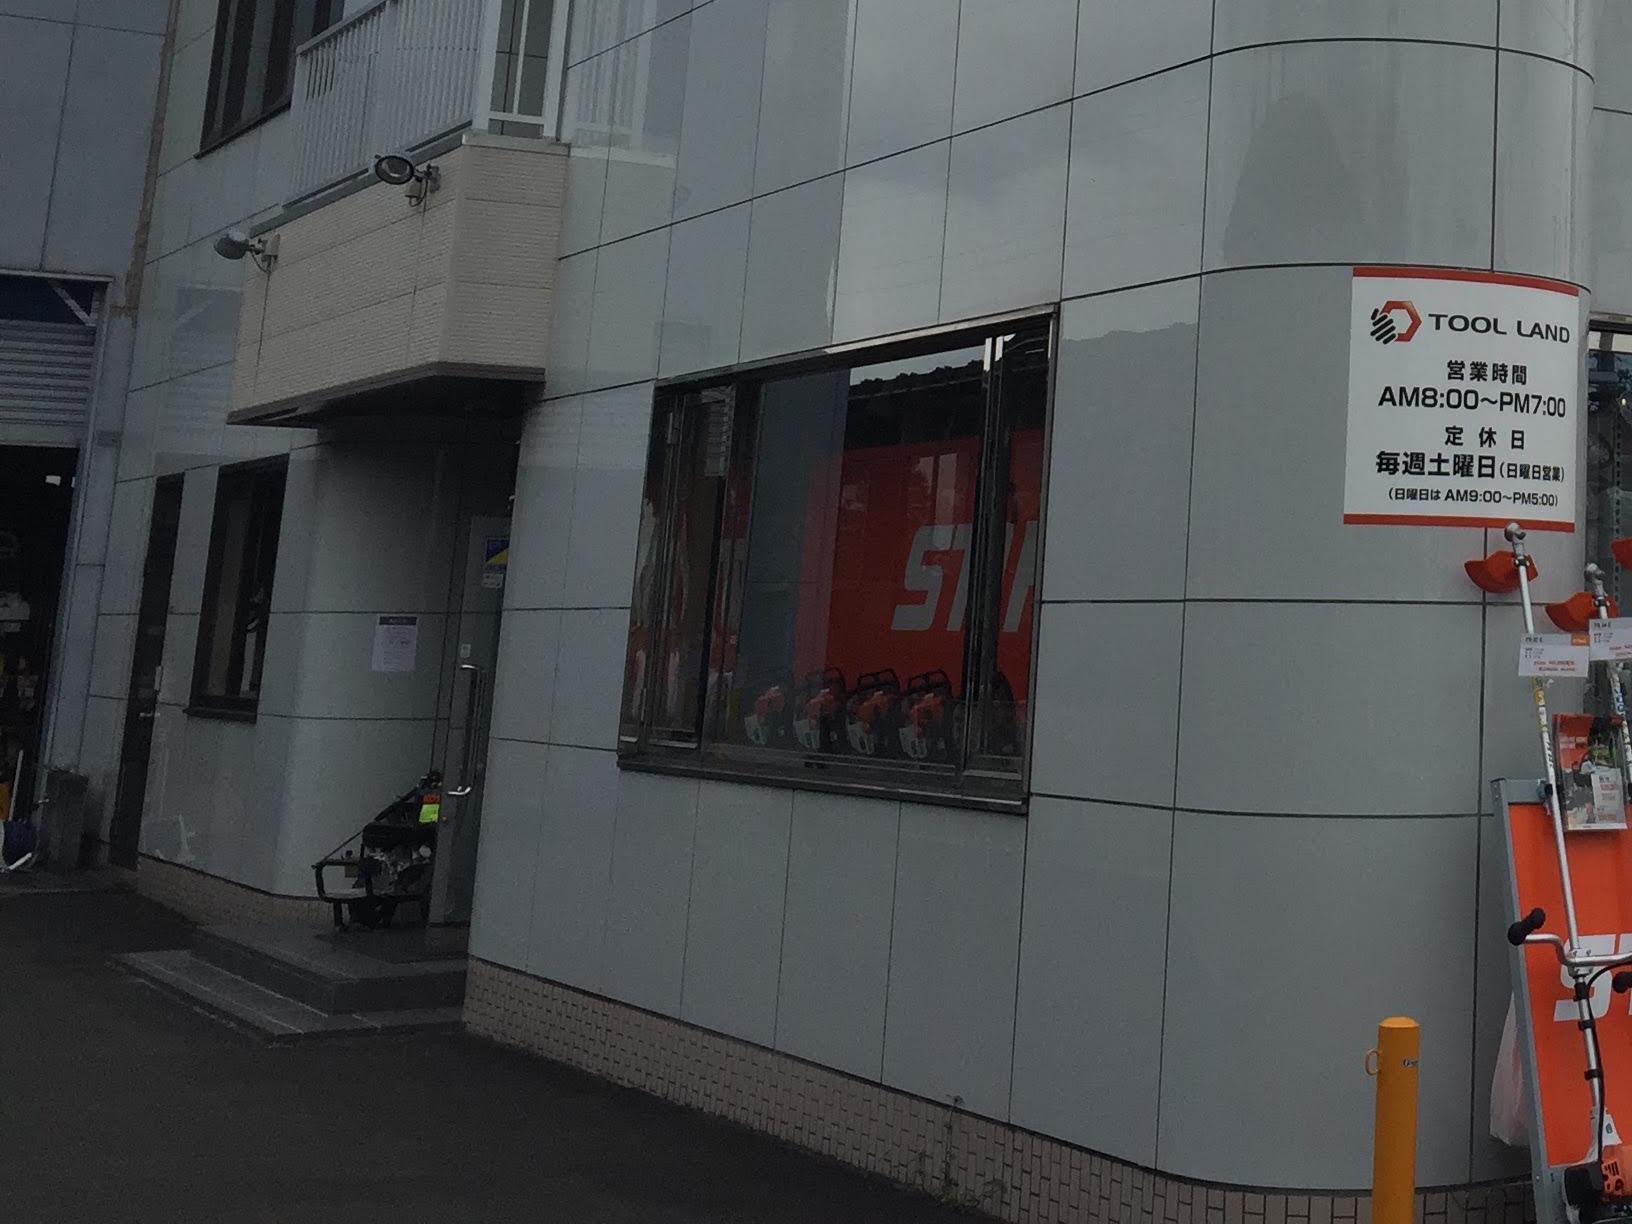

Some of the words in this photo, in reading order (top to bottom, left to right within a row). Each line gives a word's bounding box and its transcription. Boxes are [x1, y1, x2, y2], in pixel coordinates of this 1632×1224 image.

[1428, 313, 1507, 335] TOOL
[1516, 320, 1570, 343] LAND
[1447, 360, 1527, 385] 営業時間
